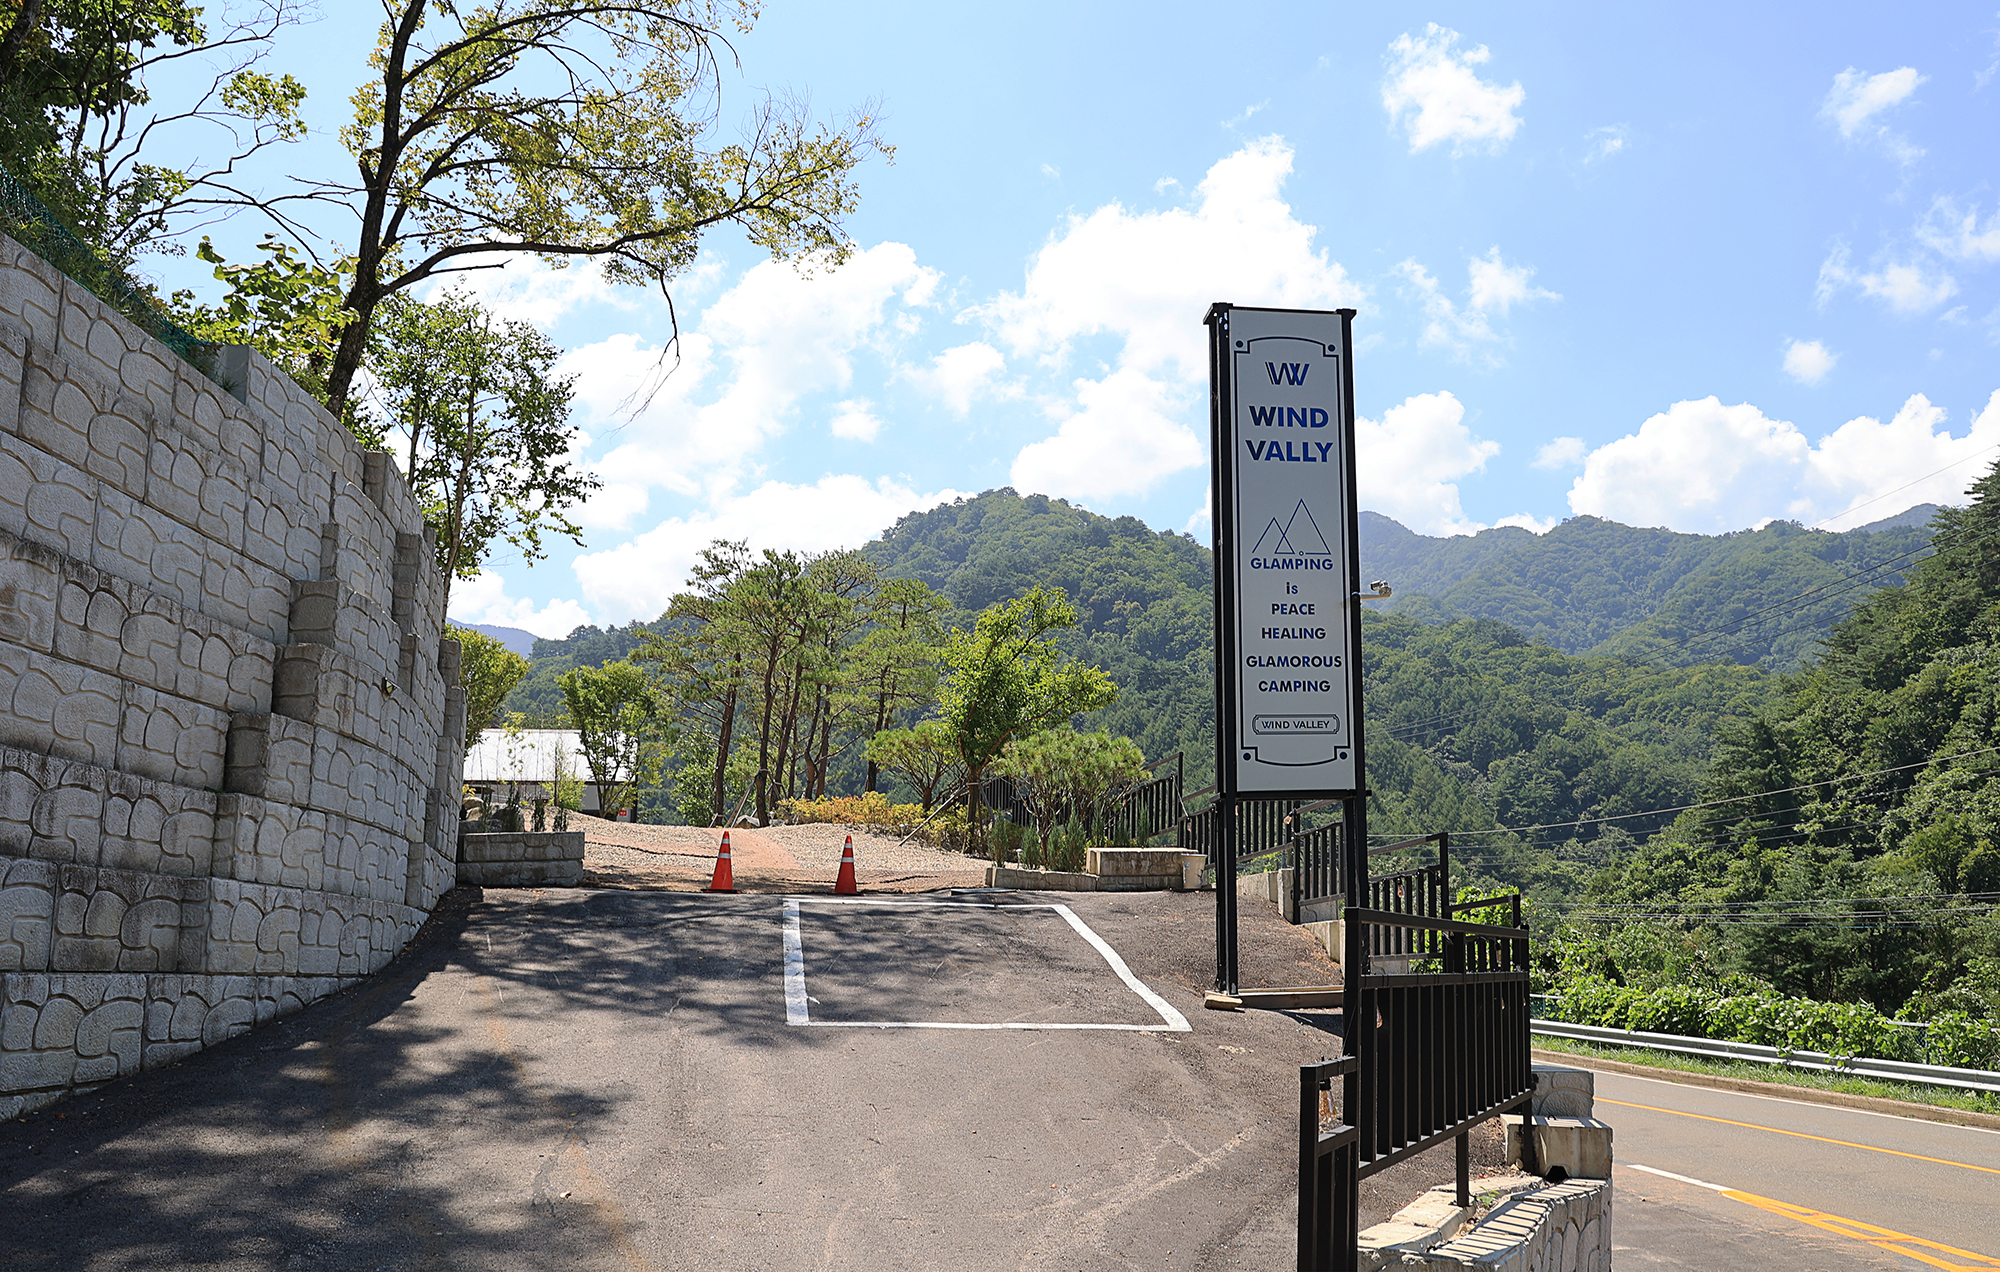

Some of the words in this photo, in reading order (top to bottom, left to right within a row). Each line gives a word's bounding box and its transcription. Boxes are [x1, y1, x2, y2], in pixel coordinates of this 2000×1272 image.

[1248, 405, 1329, 429] WIND
[1245, 439, 1333, 463] VALLY
[1250, 557, 1334, 570] GLAMPING
[1286, 582, 1299, 595] is
[1271, 603, 1316, 616] PEACE
[1261, 627, 1327, 640] HEALING
[1246, 655, 1342, 668] GLAMOROUS
[1258, 680, 1331, 692] CAMPING
[1261, 720, 1290, 729] WIND
[1292, 720, 1330, 729] VALLEY
